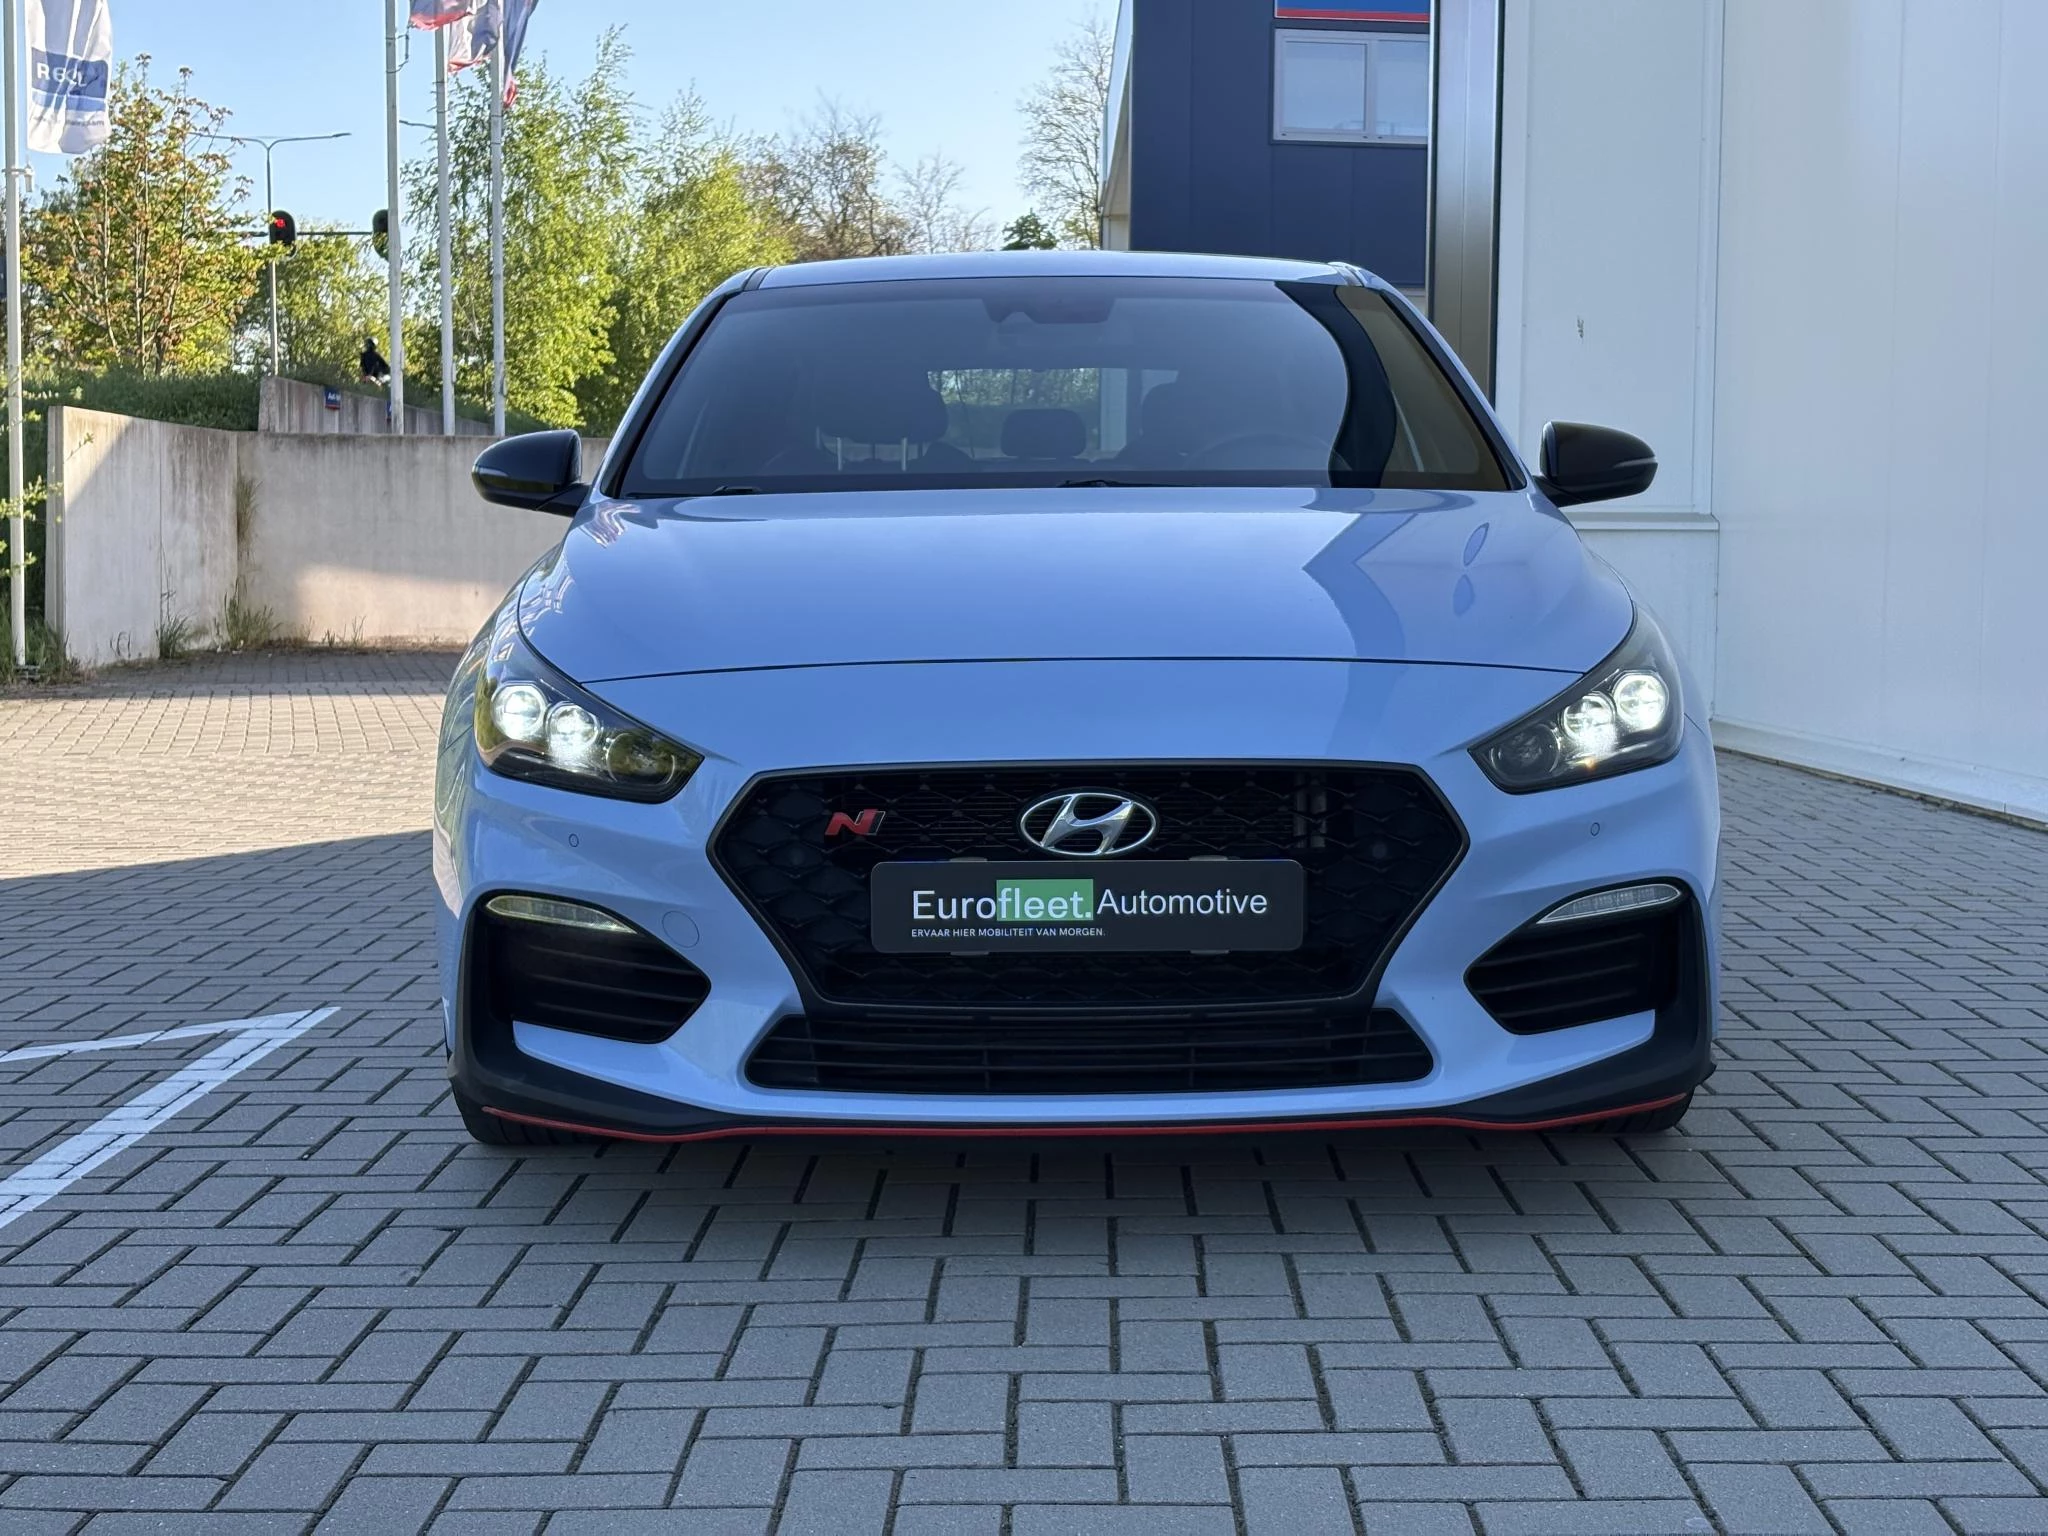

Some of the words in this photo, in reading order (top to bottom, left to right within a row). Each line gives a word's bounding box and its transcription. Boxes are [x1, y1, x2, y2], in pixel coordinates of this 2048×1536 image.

[824, 808, 886, 836] N
[912, 887, 1093, 920] Eurofleet.
[1096, 888, 1268, 915] Automotive
[911, 928, 950, 938] ERVAAR
[952, 928, 976, 937] HIER
[978, 928, 1034, 937] MOBILITEIT
[1035, 927, 1057, 937] VAN
